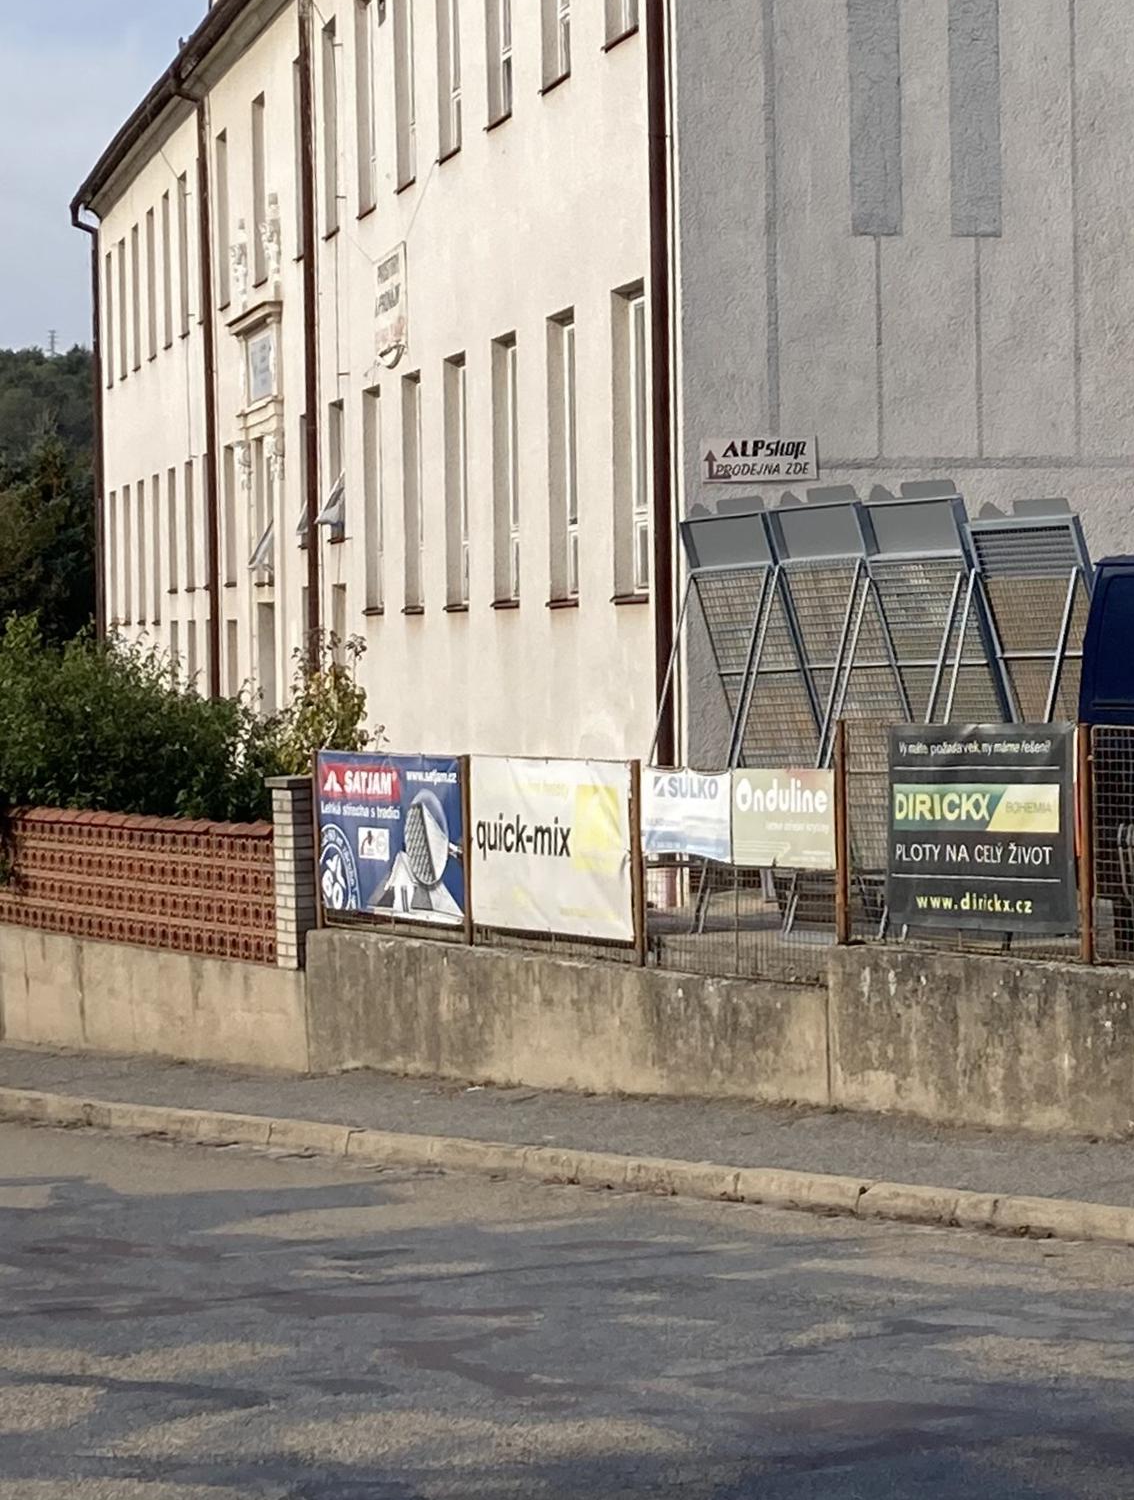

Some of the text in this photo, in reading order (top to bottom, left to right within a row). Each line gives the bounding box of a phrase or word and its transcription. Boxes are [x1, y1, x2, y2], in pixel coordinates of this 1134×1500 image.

[716, 462, 809, 476] PRODEJNA ZDE
[344, 770, 393, 795] SATJAM
[668, 777, 719, 800] SULKO
[736, 778, 828, 813] Onduline
[894, 792, 991, 821] DIRICKX
[1005, 802, 1052, 815] BOHEMIA
[476, 812, 571, 861] quick-mix
[895, 842, 1053, 865] PLOTY NA CELÝ ŽIVOT
[916, 892, 1033, 914] www.dirickx.cz
